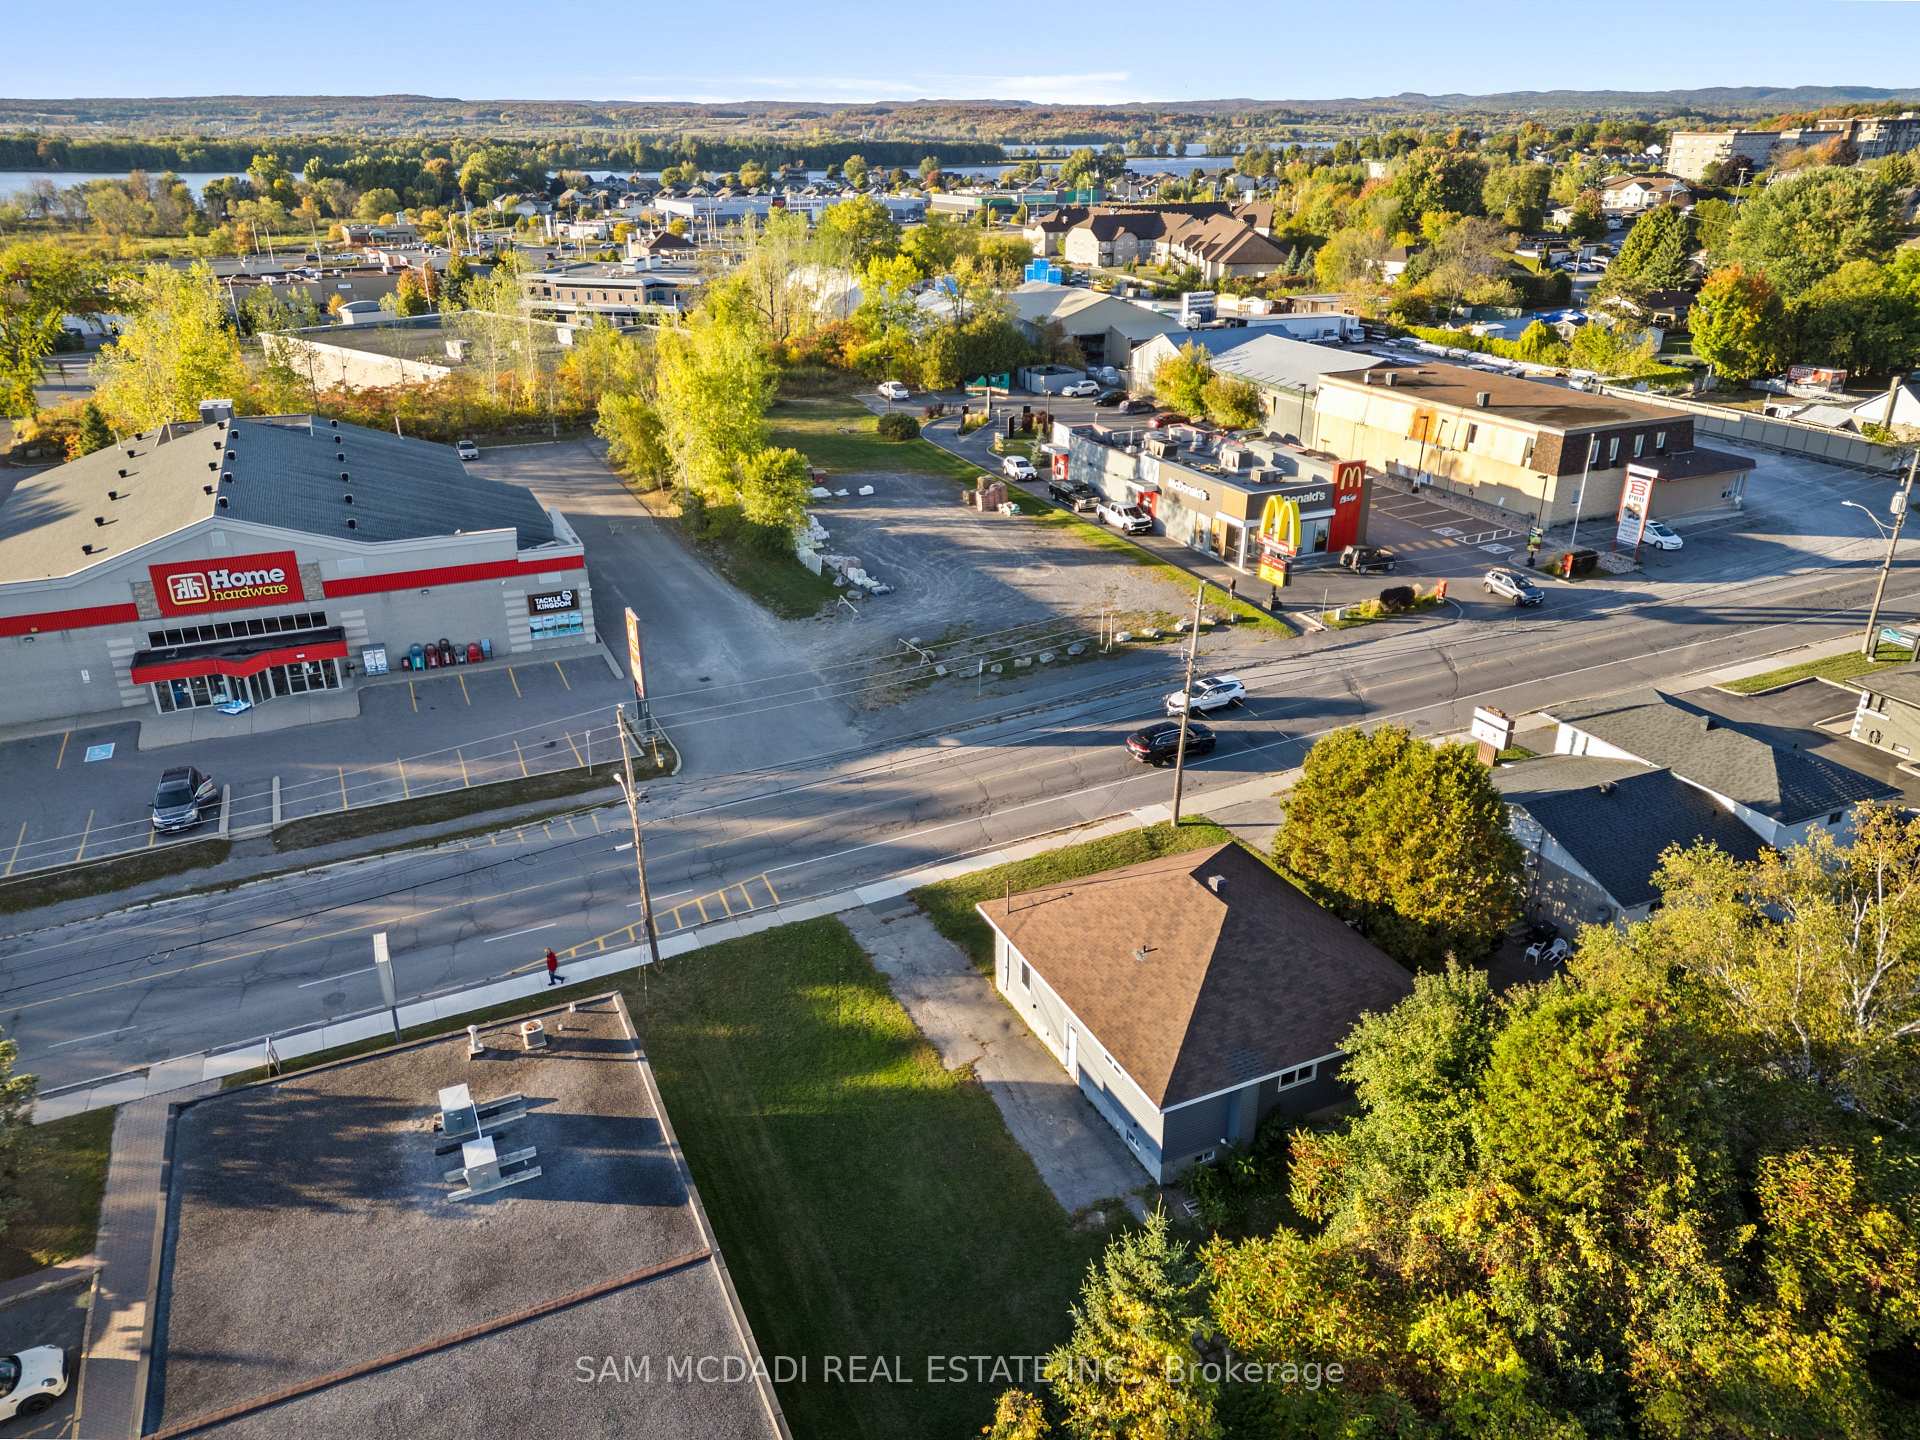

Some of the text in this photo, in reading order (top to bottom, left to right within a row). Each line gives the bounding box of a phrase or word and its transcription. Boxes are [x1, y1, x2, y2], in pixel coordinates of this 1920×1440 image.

[208, 568, 286, 589] Home
[212, 584, 289, 601] hardware
[534, 595, 562, 605] TACKLE
[537, 600, 572, 610] KINGDOM
